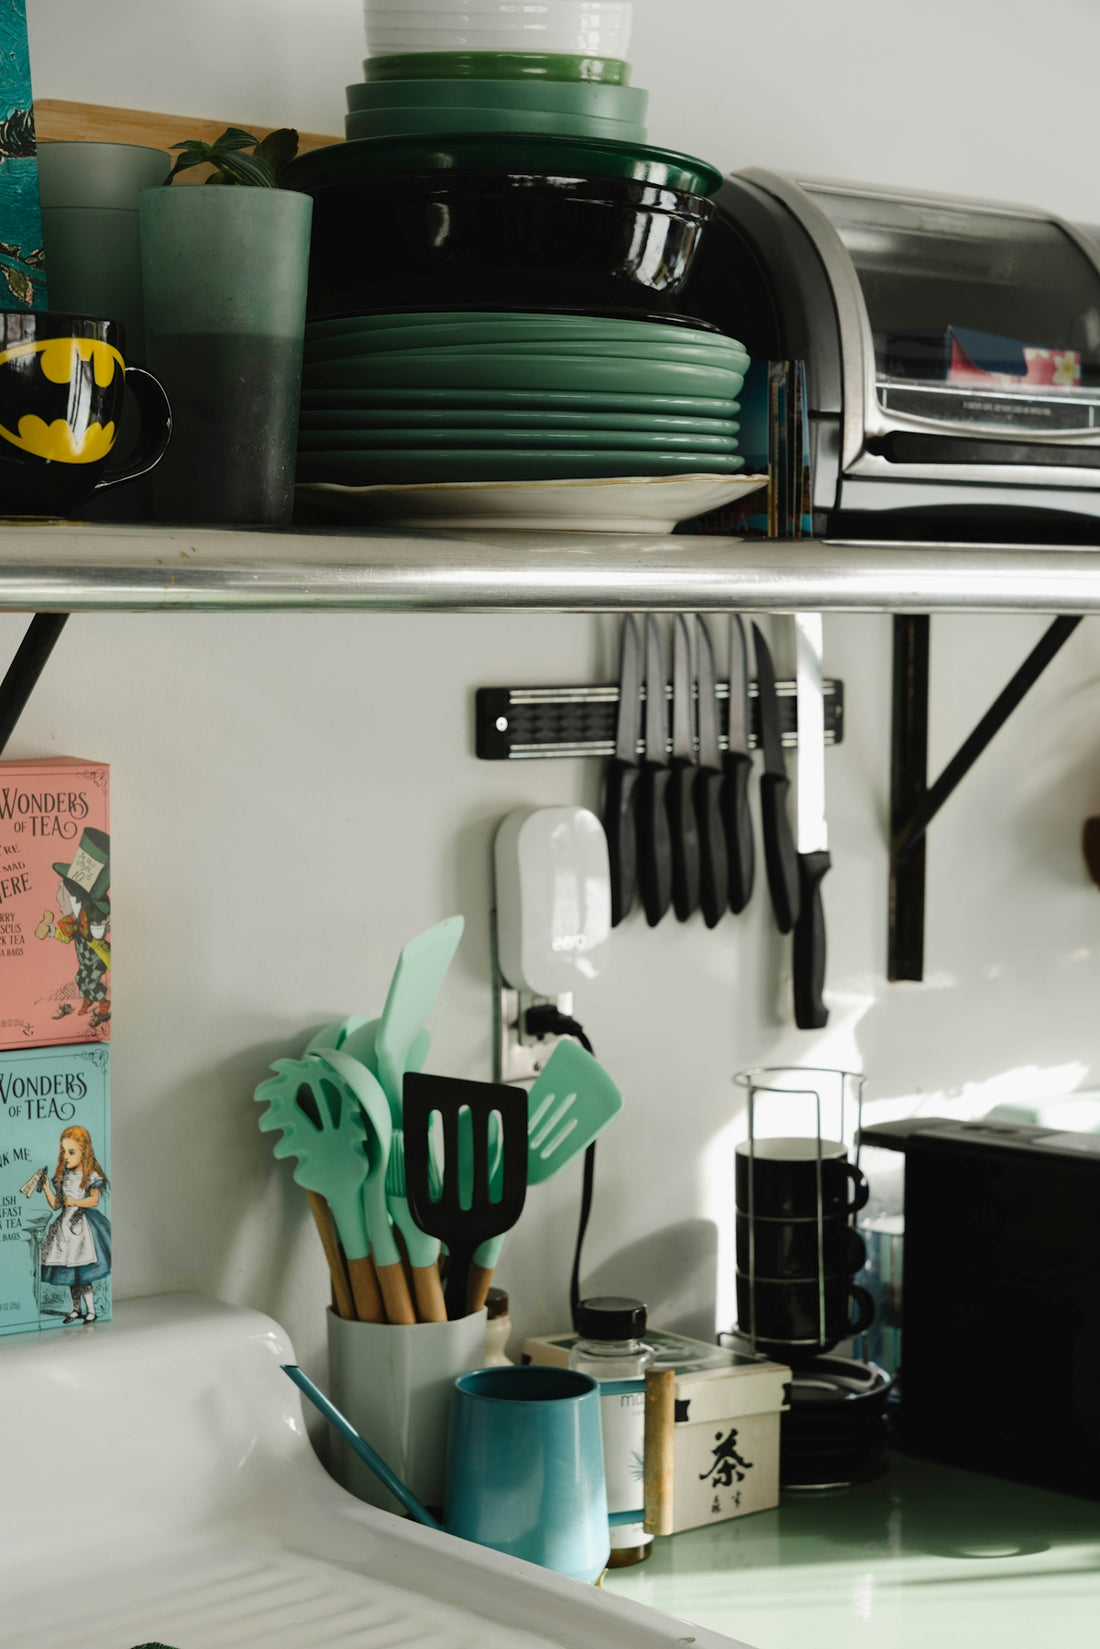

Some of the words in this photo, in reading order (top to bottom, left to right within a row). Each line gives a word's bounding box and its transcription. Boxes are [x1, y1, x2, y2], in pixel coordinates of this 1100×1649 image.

[0, 787, 88, 820] WONDERS
[14, 821, 27, 833] OF
[29, 815, 78, 840] TEA
[3, 861, 26, 872] MAD
[0, 871, 32, 901] ERE
[10, 934, 25, 945] TEA
[9, 1105, 22, 1118] OF
[24, 1098, 75, 1121] TEA
[13, 1147, 32, 1162] ME
[0, 1195, 17, 1207] ISH
[0, 1206, 22, 1218] FAST
[6, 1217, 22, 1229] TEA
[3, 1232, 20, 1242] BAGS
[699, 1428, 754, 1488] 茶
